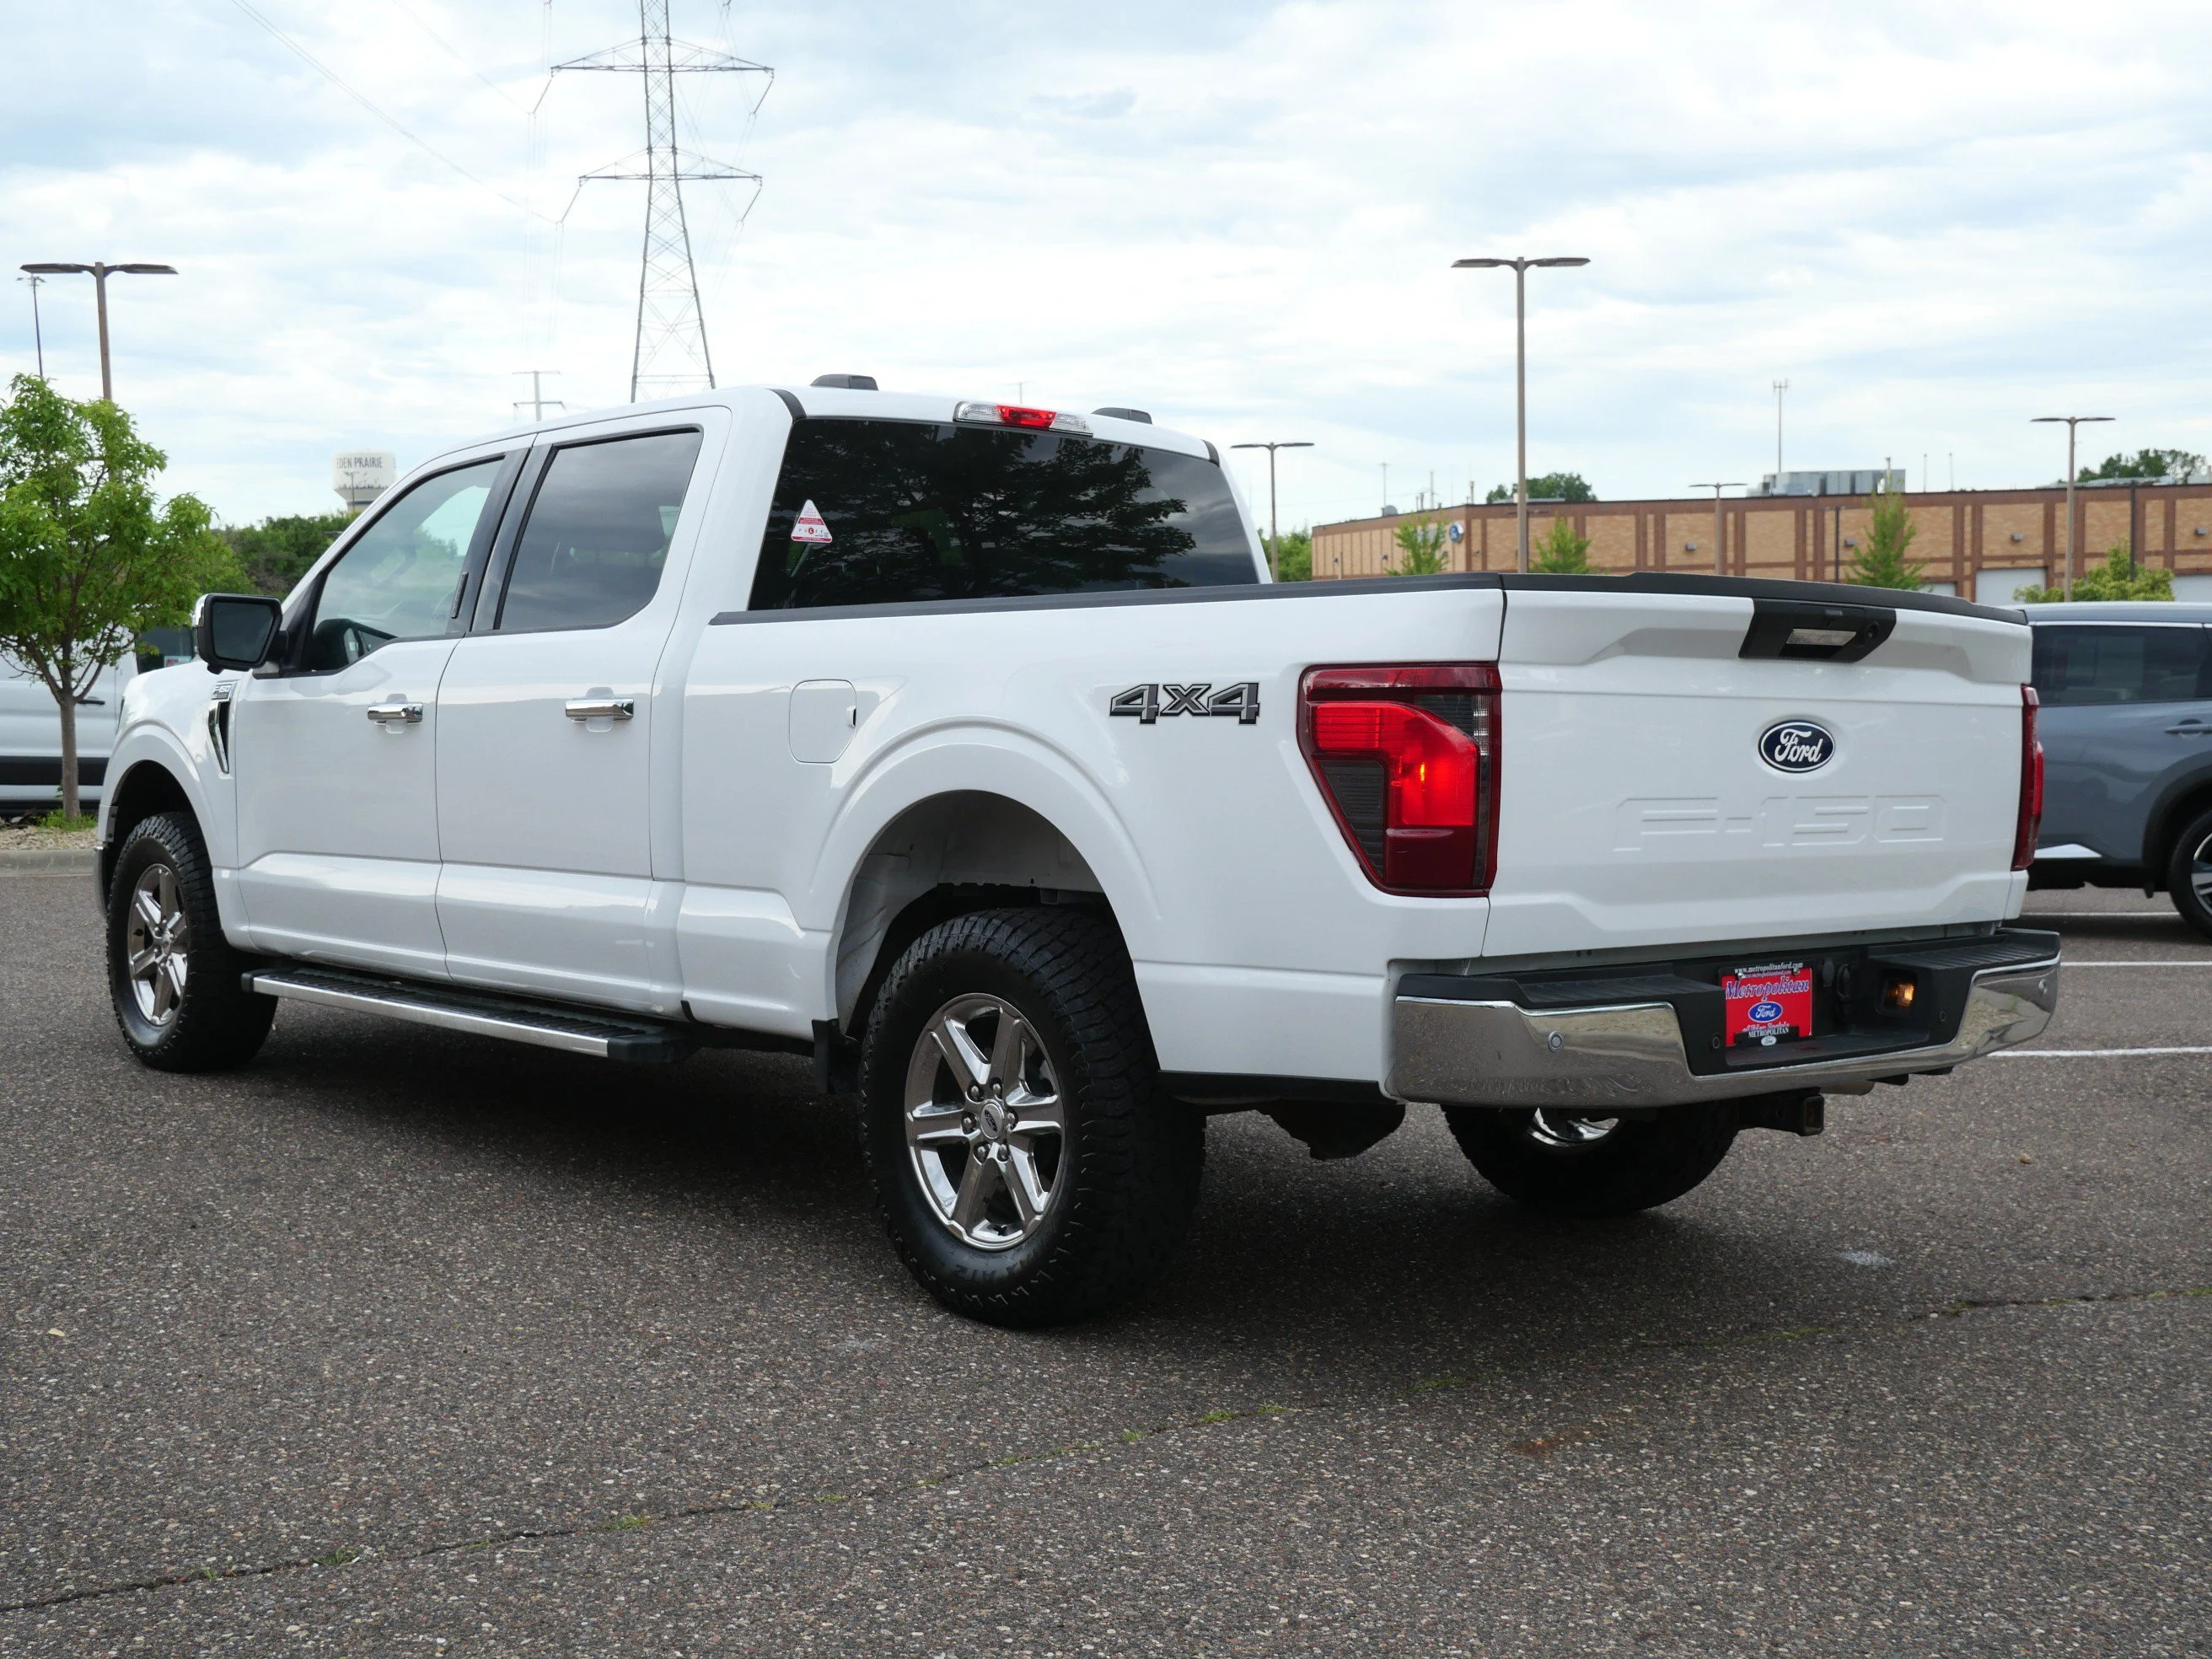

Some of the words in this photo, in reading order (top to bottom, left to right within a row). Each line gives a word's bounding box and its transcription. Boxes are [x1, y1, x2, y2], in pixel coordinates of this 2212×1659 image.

[336, 456, 352, 469] EDEN
[354, 456, 384, 469] PRAIRIE
[1109, 683, 1260, 724] 4X4
[1774, 727, 1823, 764] Ford
[1613, 794, 1947, 851] F-150
[1726, 975, 1809, 1001] Metropolitan
[1755, 1005, 1775, 1018] Ford
[1748, 1028, 1790, 1038] METROPOLITAN
